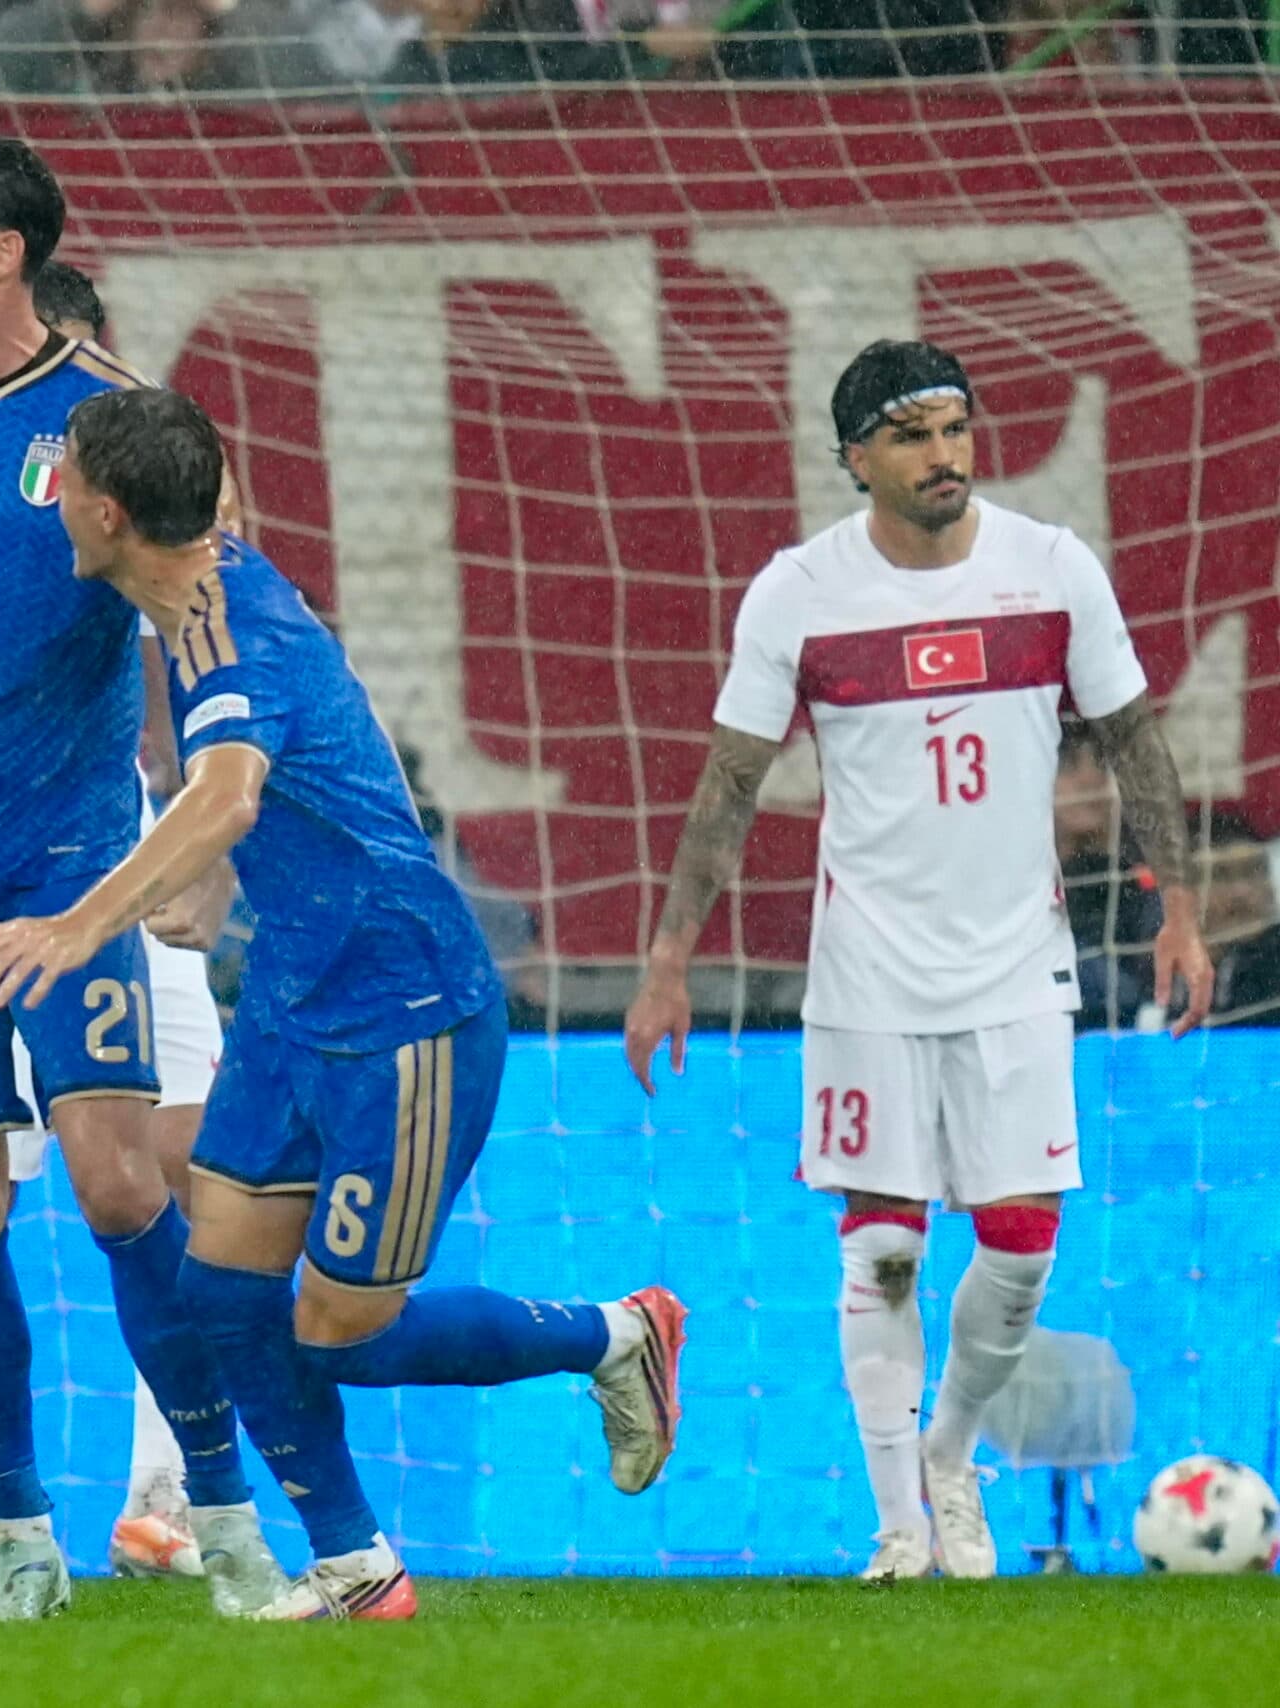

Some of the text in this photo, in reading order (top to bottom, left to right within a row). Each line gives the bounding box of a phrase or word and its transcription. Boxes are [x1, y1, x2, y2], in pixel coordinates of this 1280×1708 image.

[926, 732, 987, 806] 13
[83, 977, 149, 1065] 21
[816, 1086, 869, 1158] 13
